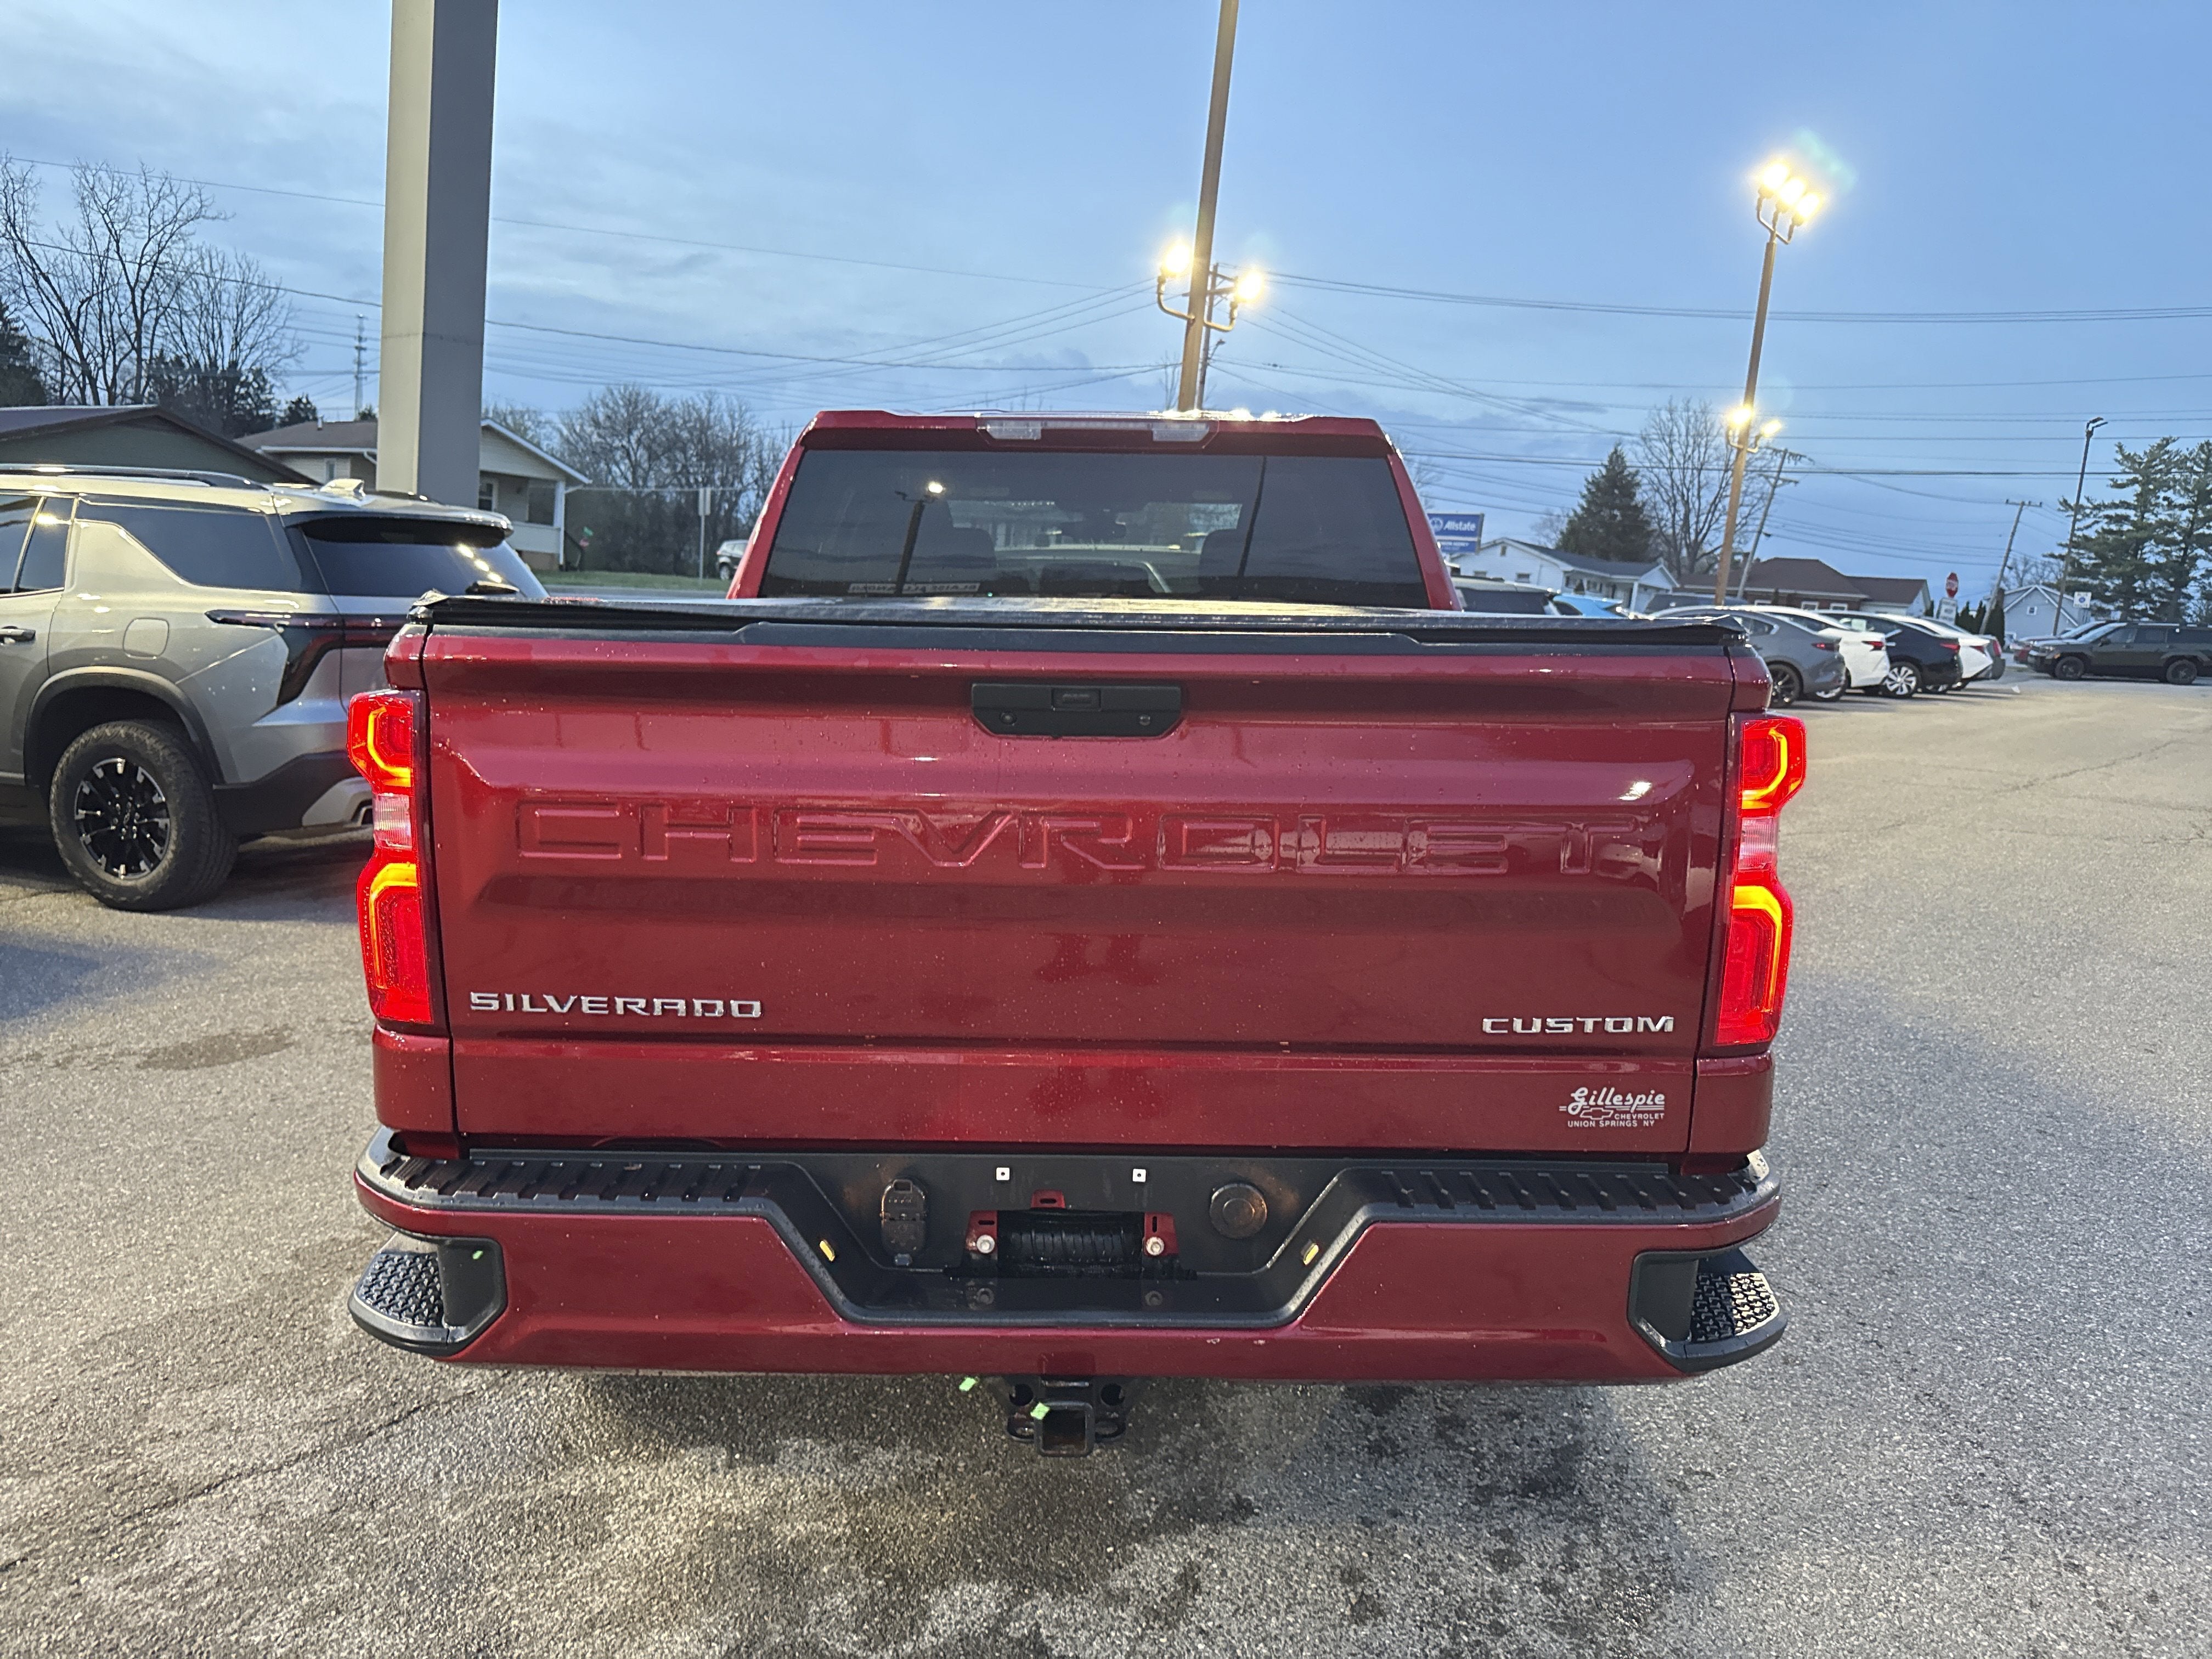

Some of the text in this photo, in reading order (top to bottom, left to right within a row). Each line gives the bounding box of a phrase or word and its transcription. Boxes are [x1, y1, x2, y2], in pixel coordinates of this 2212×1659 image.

[1443, 521, 1476, 532] Allstate
[516, 803, 1639, 875] CHEVROLET
[470, 992, 761, 1018] SILVERADO
[1481, 1016, 1674, 1033] CUSTOM
[1567, 1087, 1665, 1115] Gillespie
